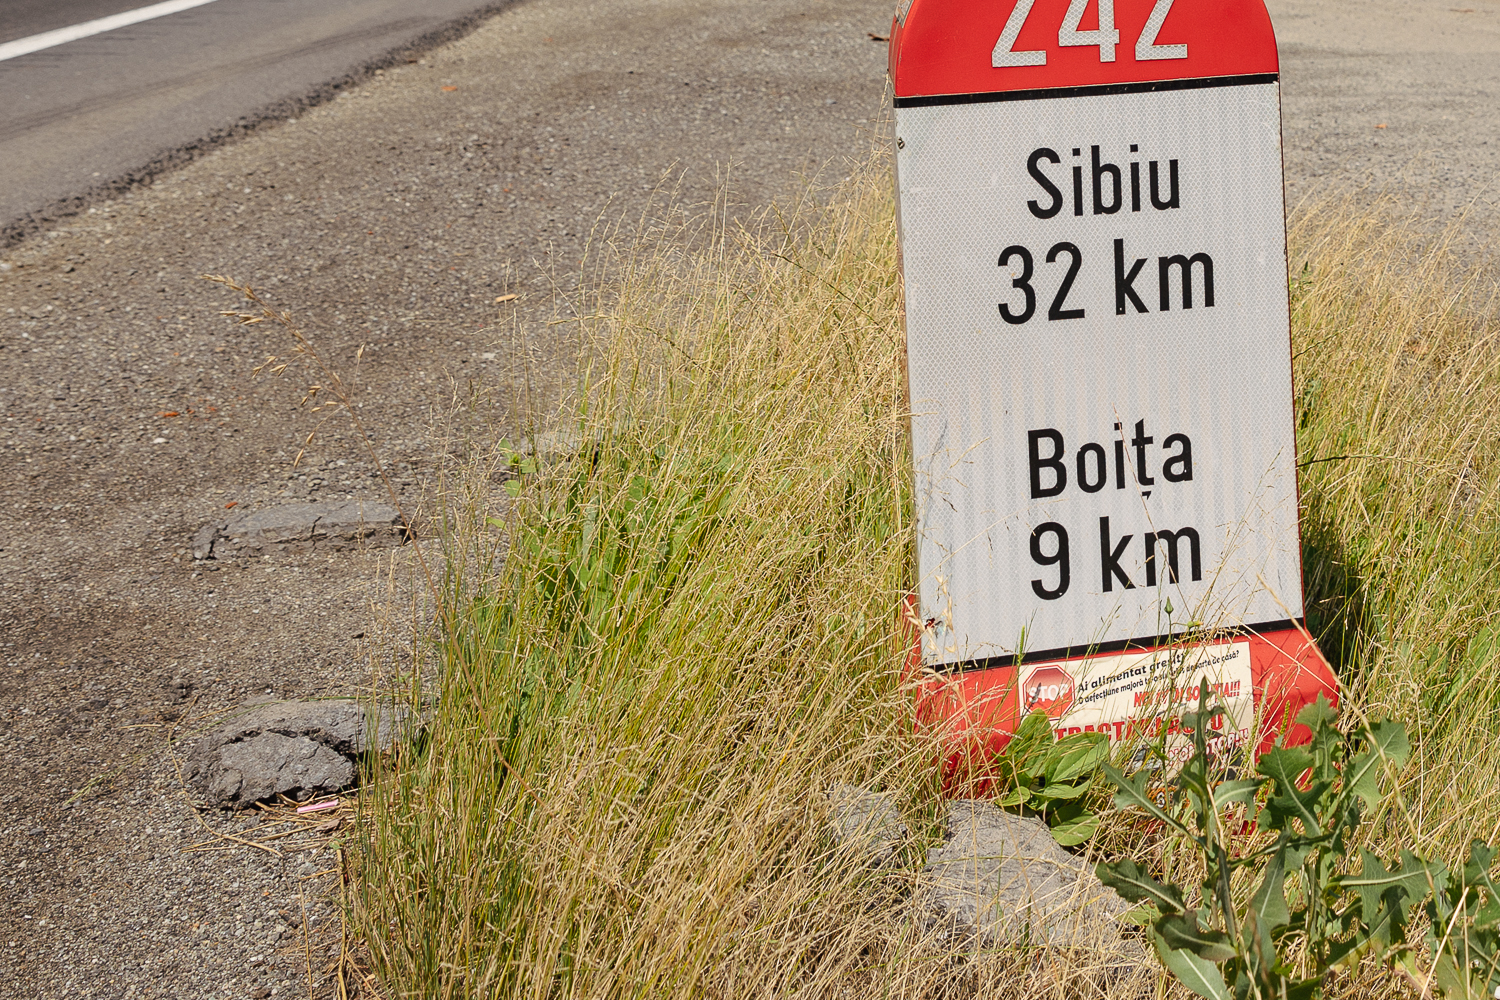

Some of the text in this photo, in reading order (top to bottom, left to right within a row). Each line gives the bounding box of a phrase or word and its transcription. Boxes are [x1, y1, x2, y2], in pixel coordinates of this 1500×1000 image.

[1026, 144, 1181, 219] Sibiu
[997, 238, 1216, 325] 32 km
[1027, 418, 1194, 500] Boița
[1029, 516, 1202, 601] 9 km
[1029, 683, 1068, 703] STOP
[1091, 665, 1147, 690] alimentat
